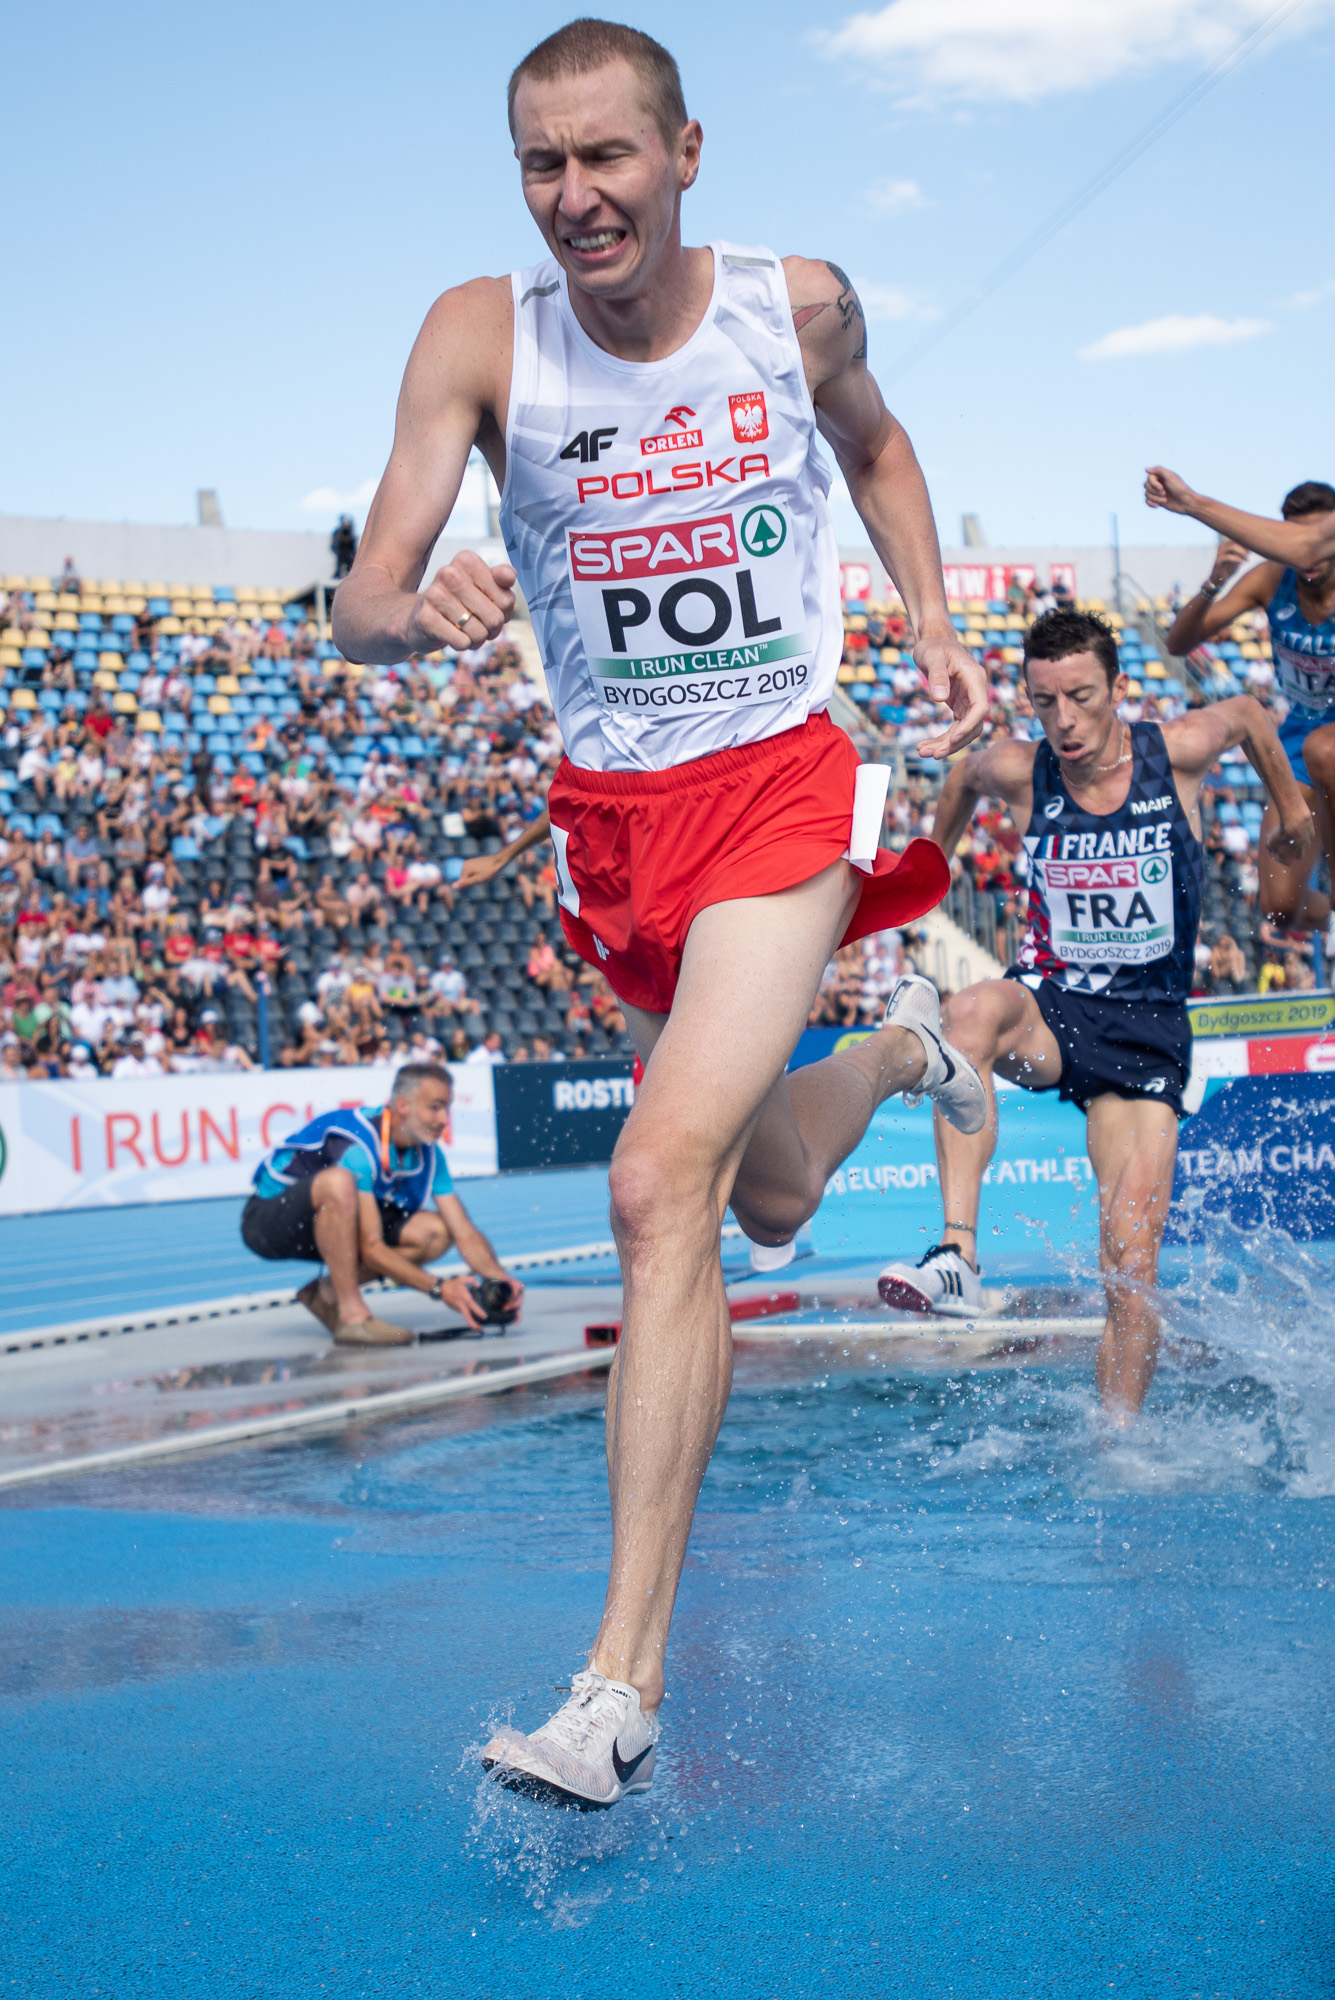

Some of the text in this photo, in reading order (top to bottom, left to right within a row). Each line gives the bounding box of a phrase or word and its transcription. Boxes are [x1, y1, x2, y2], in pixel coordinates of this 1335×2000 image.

[731, 393, 762, 404] POLSKA
[559, 427, 619, 463] 4F
[643, 432, 699, 453] ORLEN
[576, 453, 771, 504] POLSKA
[574, 522, 734, 575] SPAR
[601, 569, 782, 653] POL
[640, 652, 686, 677] RUN
[603, 664, 808, 706] BYDGOSZCZ 2019
[1131, 795, 1173, 815] MAIF
[1061, 821, 1172, 860] FRANCE
[1049, 864, 1136, 886] SPAR
[1066, 891, 1157, 929] FRA
[1060, 939, 1172, 960] BYDGOSZCZ 2019
[1082, 932, 1107, 943] RUN
[1198, 1003, 1328, 1031] Bydgoszcz 2019
[71, 1114, 82, 1173] I
[105, 1106, 240, 1171] RUN
[1178, 1147, 1263, 1177] TEAM
[849, 1164, 991, 1191] EUROP
